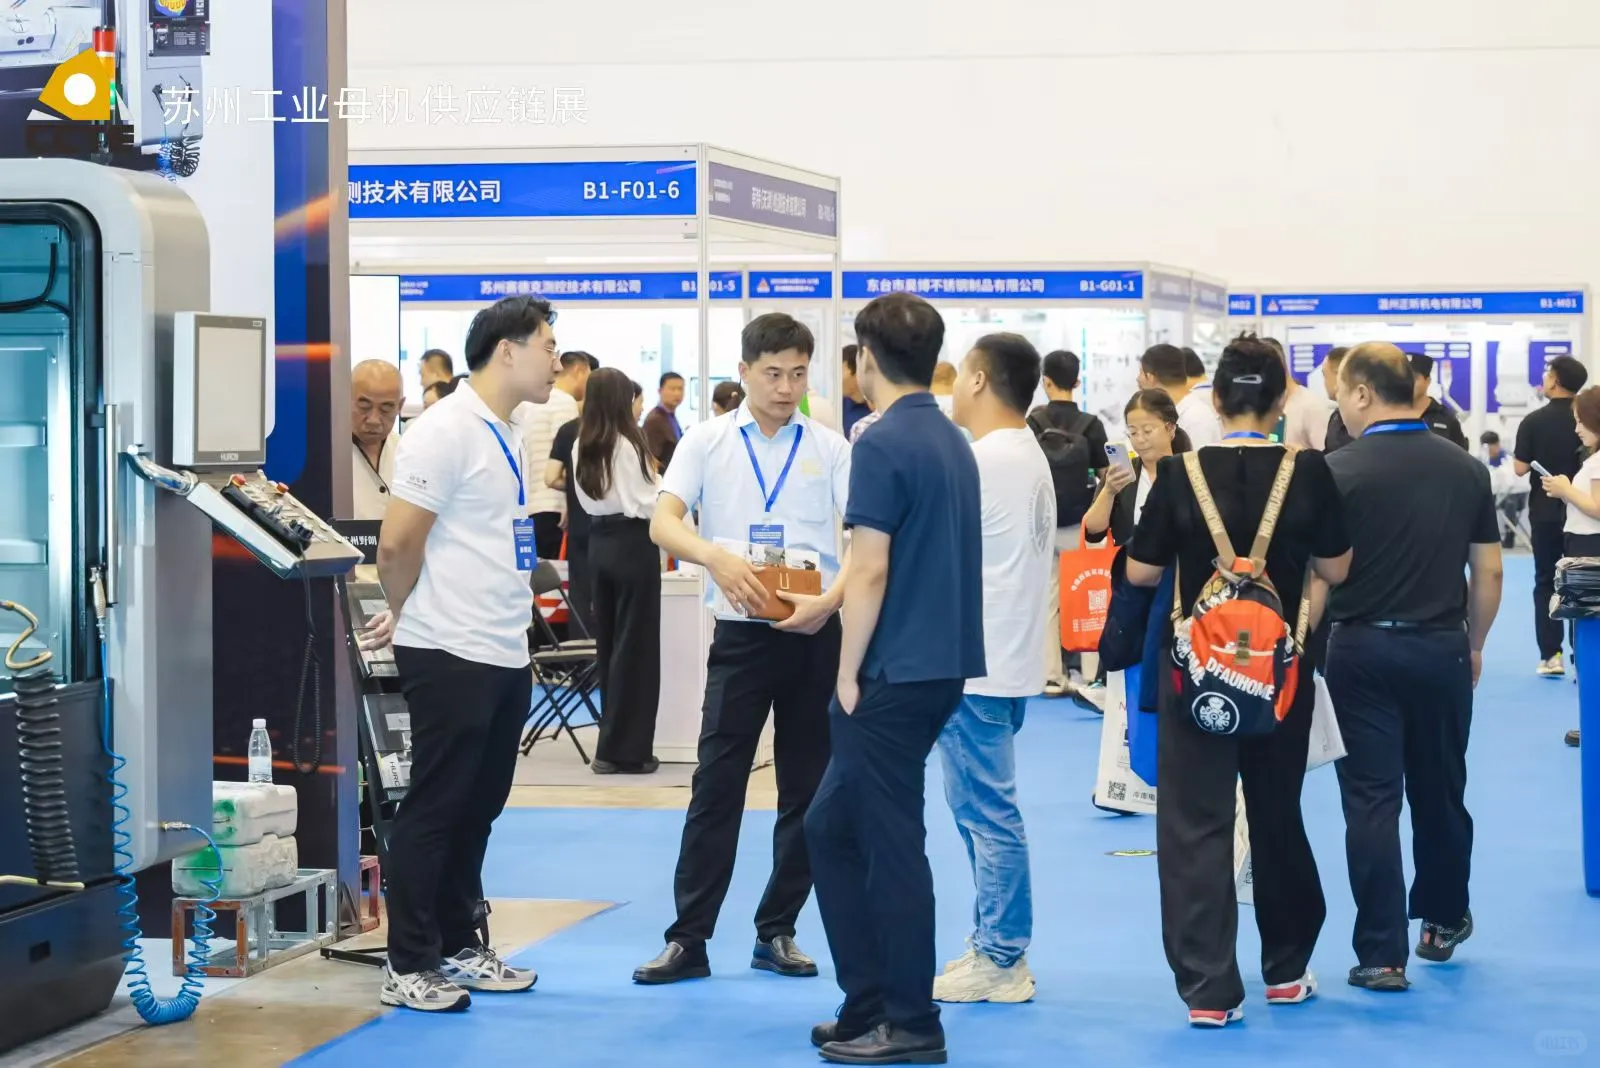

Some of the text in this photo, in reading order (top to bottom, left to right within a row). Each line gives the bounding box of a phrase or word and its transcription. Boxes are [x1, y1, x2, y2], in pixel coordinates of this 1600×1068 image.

[583, 181, 680, 200] B1-F01-6
[1079, 279, 1135, 293] B1-G01-1
[1539, 297, 1578, 309] B1-M01
[1205, 656, 1276, 701] DFAUHOME
